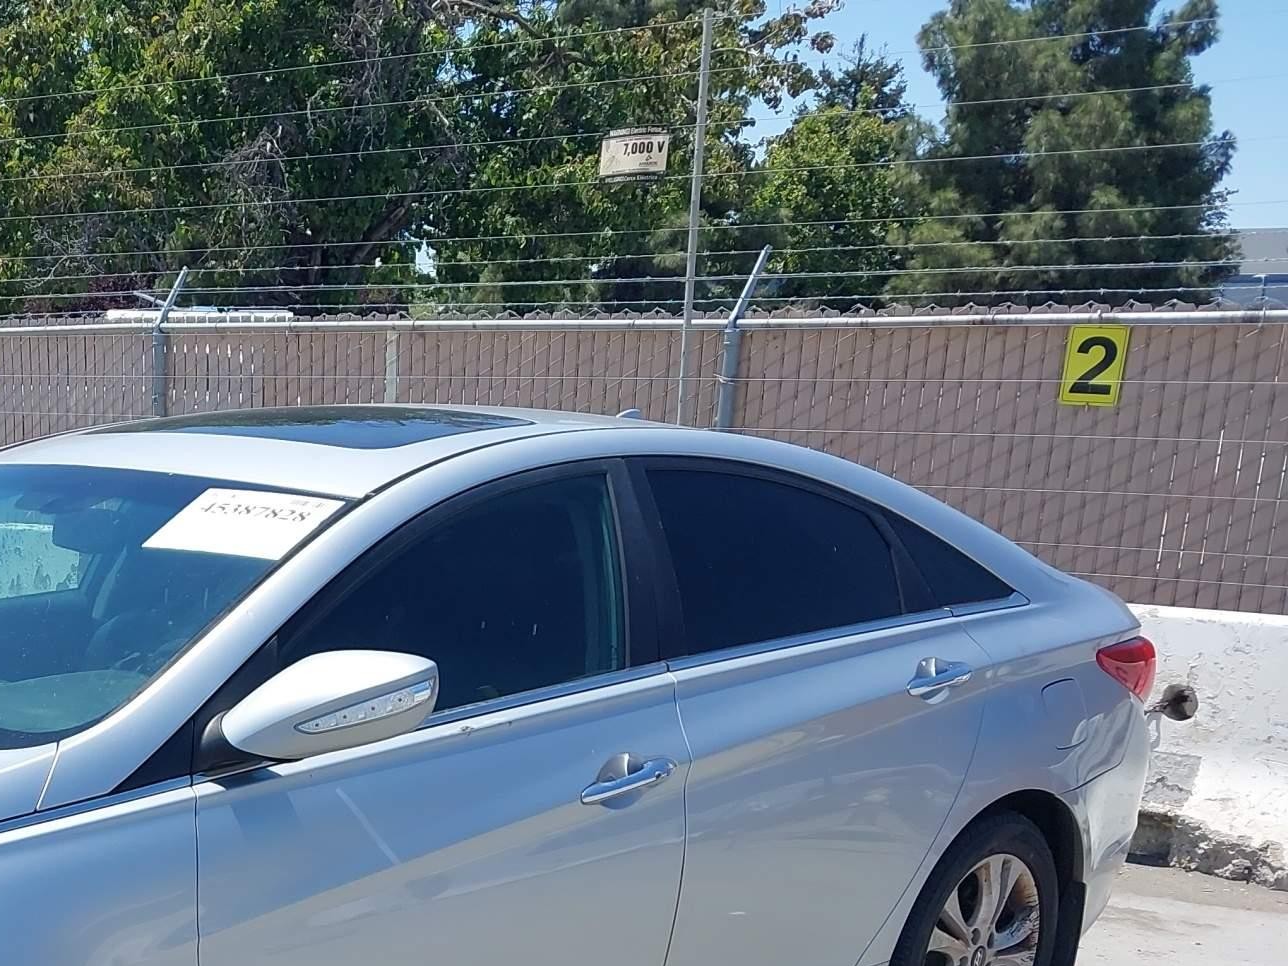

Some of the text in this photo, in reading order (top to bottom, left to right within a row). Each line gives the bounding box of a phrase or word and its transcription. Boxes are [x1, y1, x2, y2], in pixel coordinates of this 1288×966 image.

[624, 141, 665, 156] 7,000 V
[1069, 336, 1118, 395] 2
[201, 502, 311, 522] 45387828
